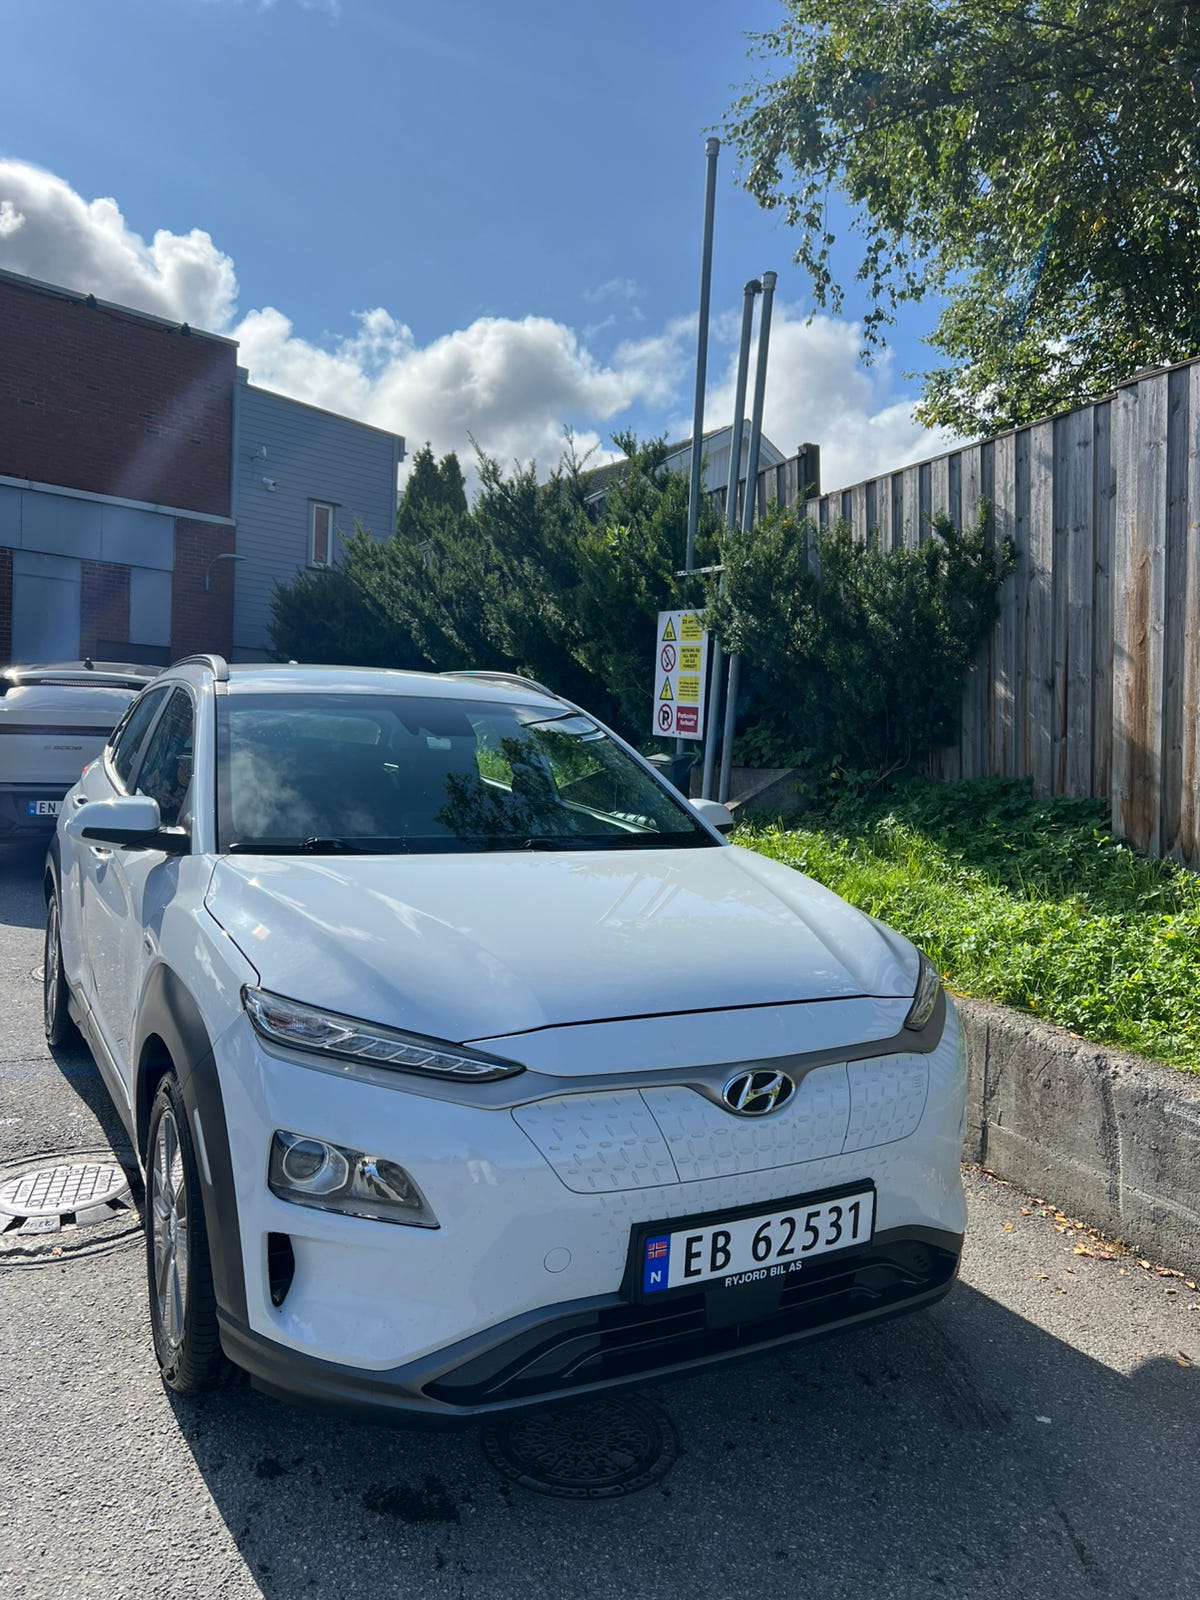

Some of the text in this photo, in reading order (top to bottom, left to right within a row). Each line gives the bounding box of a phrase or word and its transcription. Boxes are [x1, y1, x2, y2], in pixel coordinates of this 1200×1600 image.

[39, 803, 56, 813] EN
[684, 1201, 861, 1278] EB 62531
[650, 1270, 661, 1284] N
[725, 1260, 802, 1287] RYJORD BIL AS
